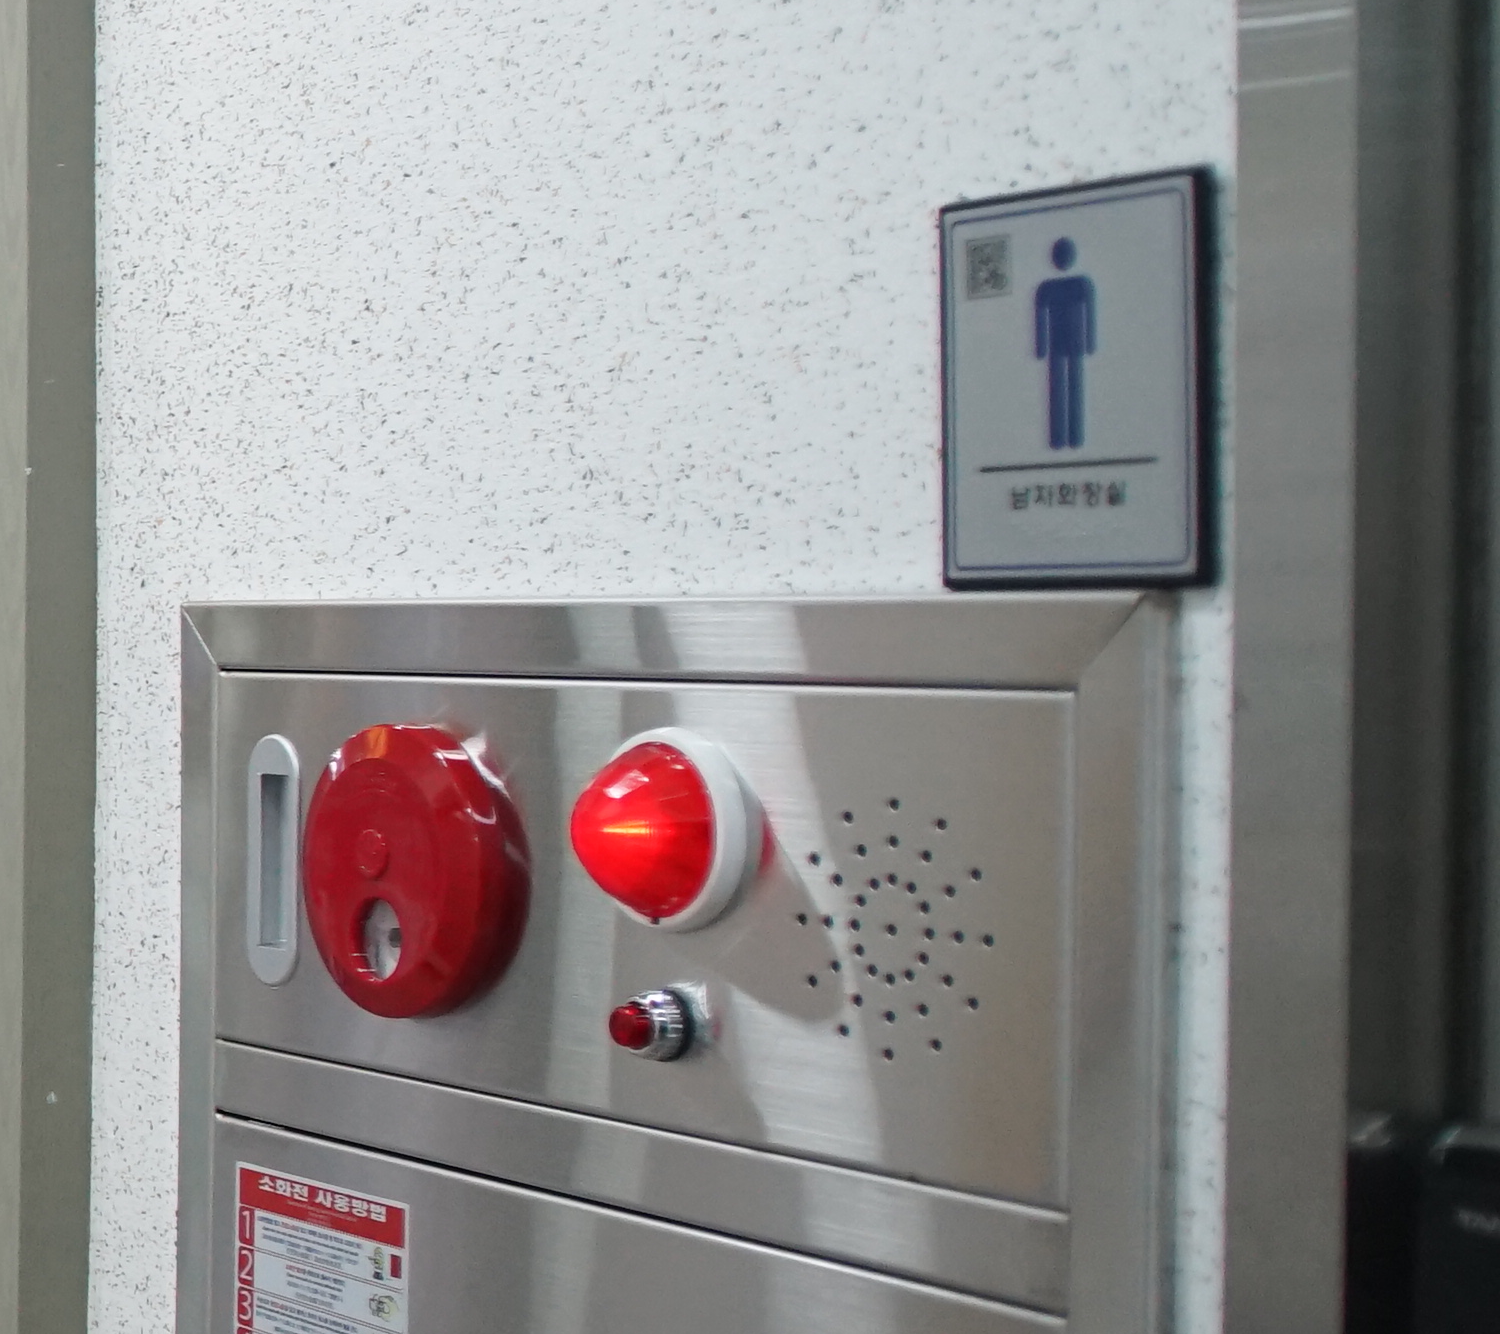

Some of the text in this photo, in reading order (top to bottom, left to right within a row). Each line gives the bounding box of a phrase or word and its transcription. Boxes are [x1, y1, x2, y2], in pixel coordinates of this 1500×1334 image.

[1011, 480, 1127, 510] 남자화장실
[258, 1175, 310, 1203] 소화전
[315, 1188, 388, 1223] 사용방법
[241, 1210, 250, 1241] 1
[240, 1249, 253, 1281] 2
[240, 1289, 252, 1320] 3
